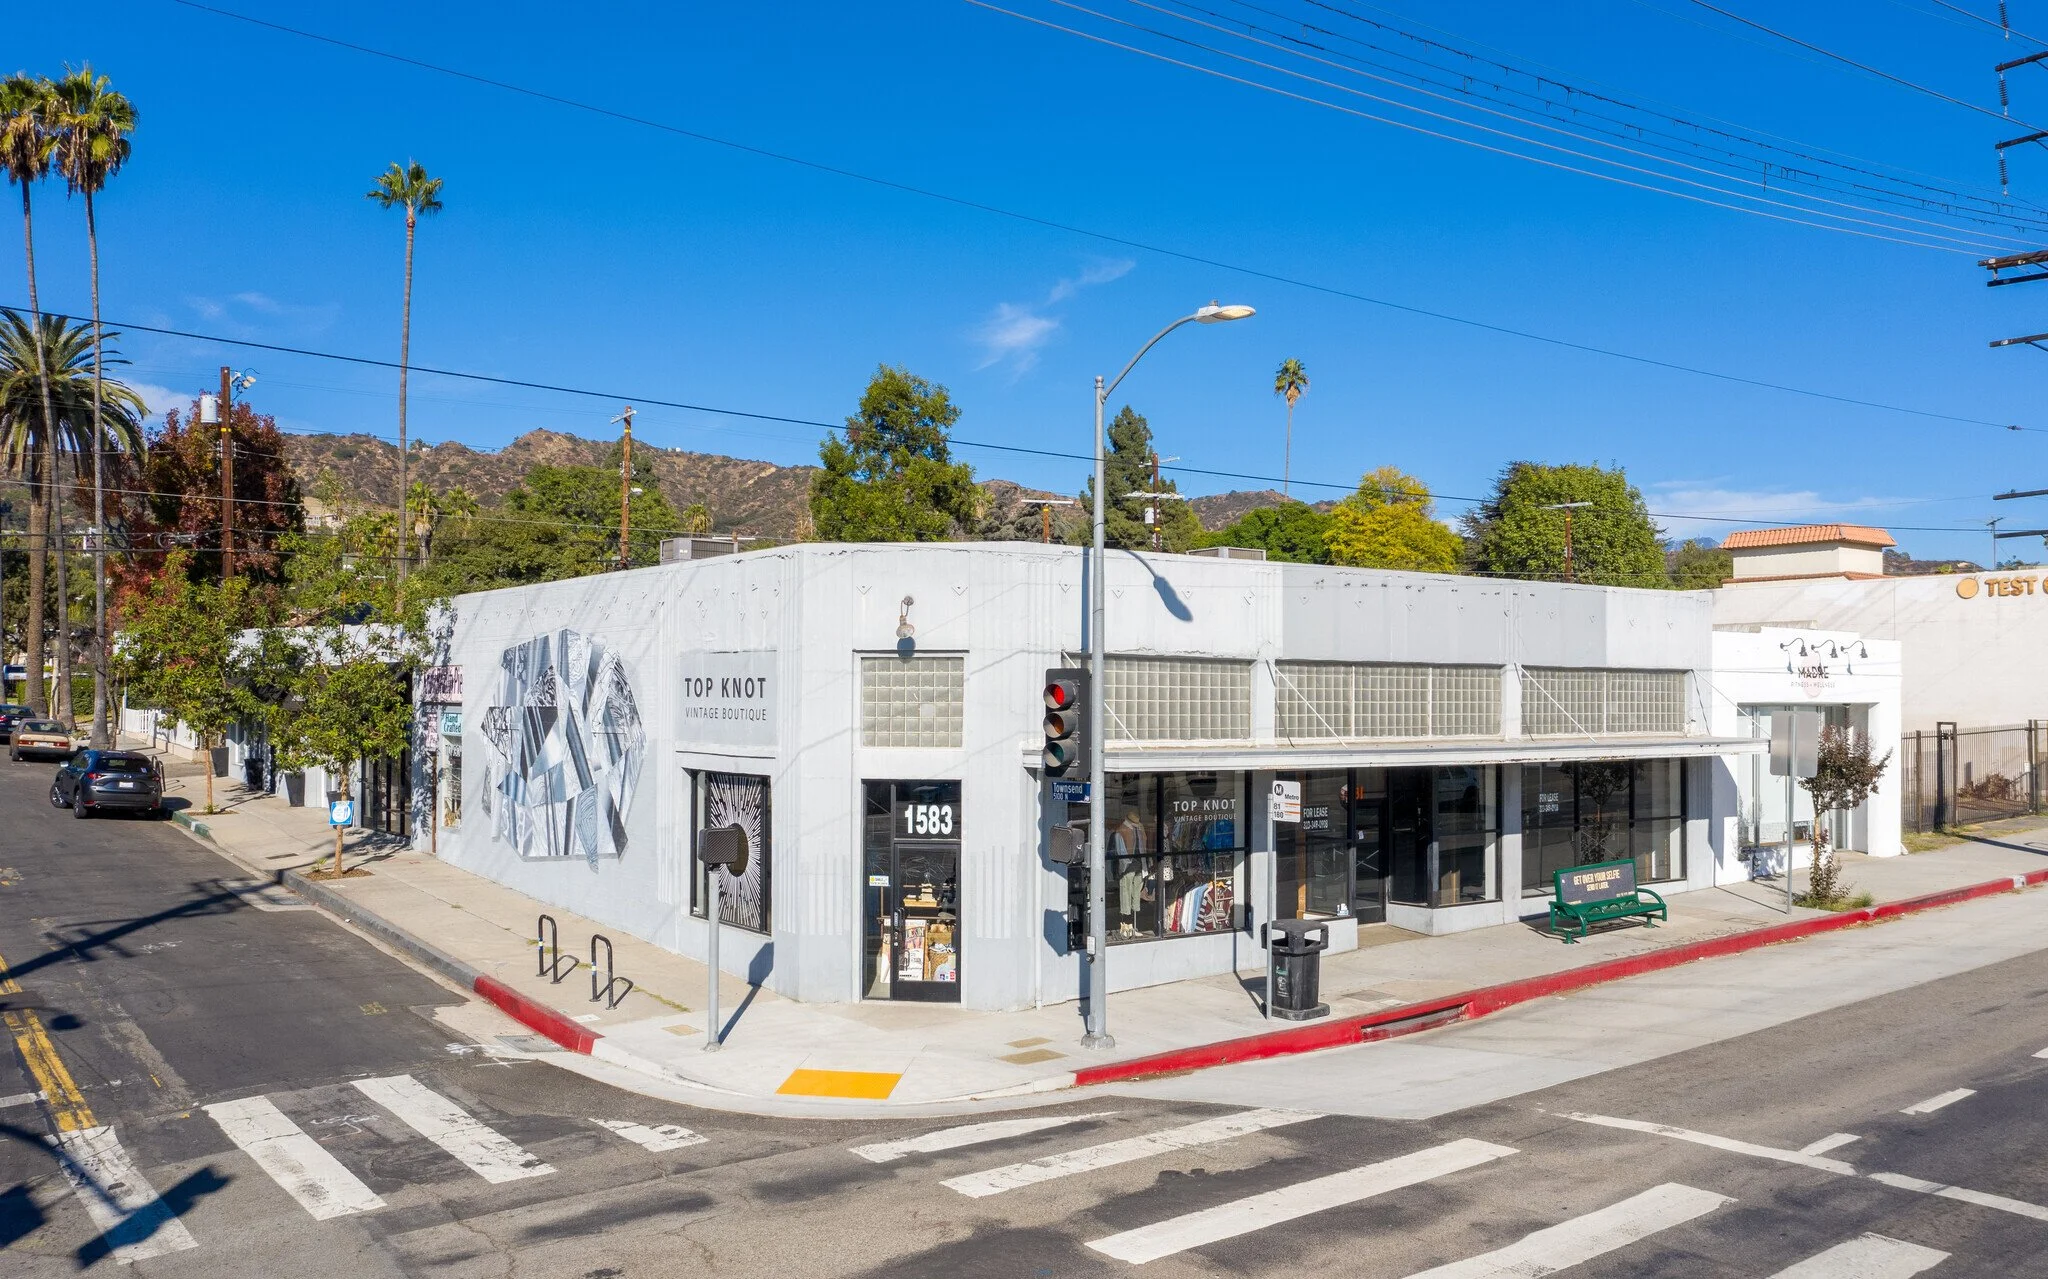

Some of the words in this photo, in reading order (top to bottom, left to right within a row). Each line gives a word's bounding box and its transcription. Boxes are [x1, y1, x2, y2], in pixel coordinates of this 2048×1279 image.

[1984, 576, 2038, 597] TEST
[1798, 666, 1829, 678] MADRE
[685, 677, 713, 698] TOP
[721, 677, 766, 698] KNOT
[685, 707, 718, 719] VINTAGE
[722, 707, 766, 721] BOUTIQUE
[1053, 782, 1083, 793] Townsend
[1173, 800, 1198, 812] TOP
[1203, 799, 1236, 811] KNOT
[1173, 814, 1202, 822] VINTAGE
[1204, 813, 1237, 821] BOUTIQUE
[1303, 807, 1313, 818] FOR
[1313, 806, 1328, 817] LEASE
[904, 804, 953, 835] 1583
[1606, 869, 1621, 880] SELFIE
